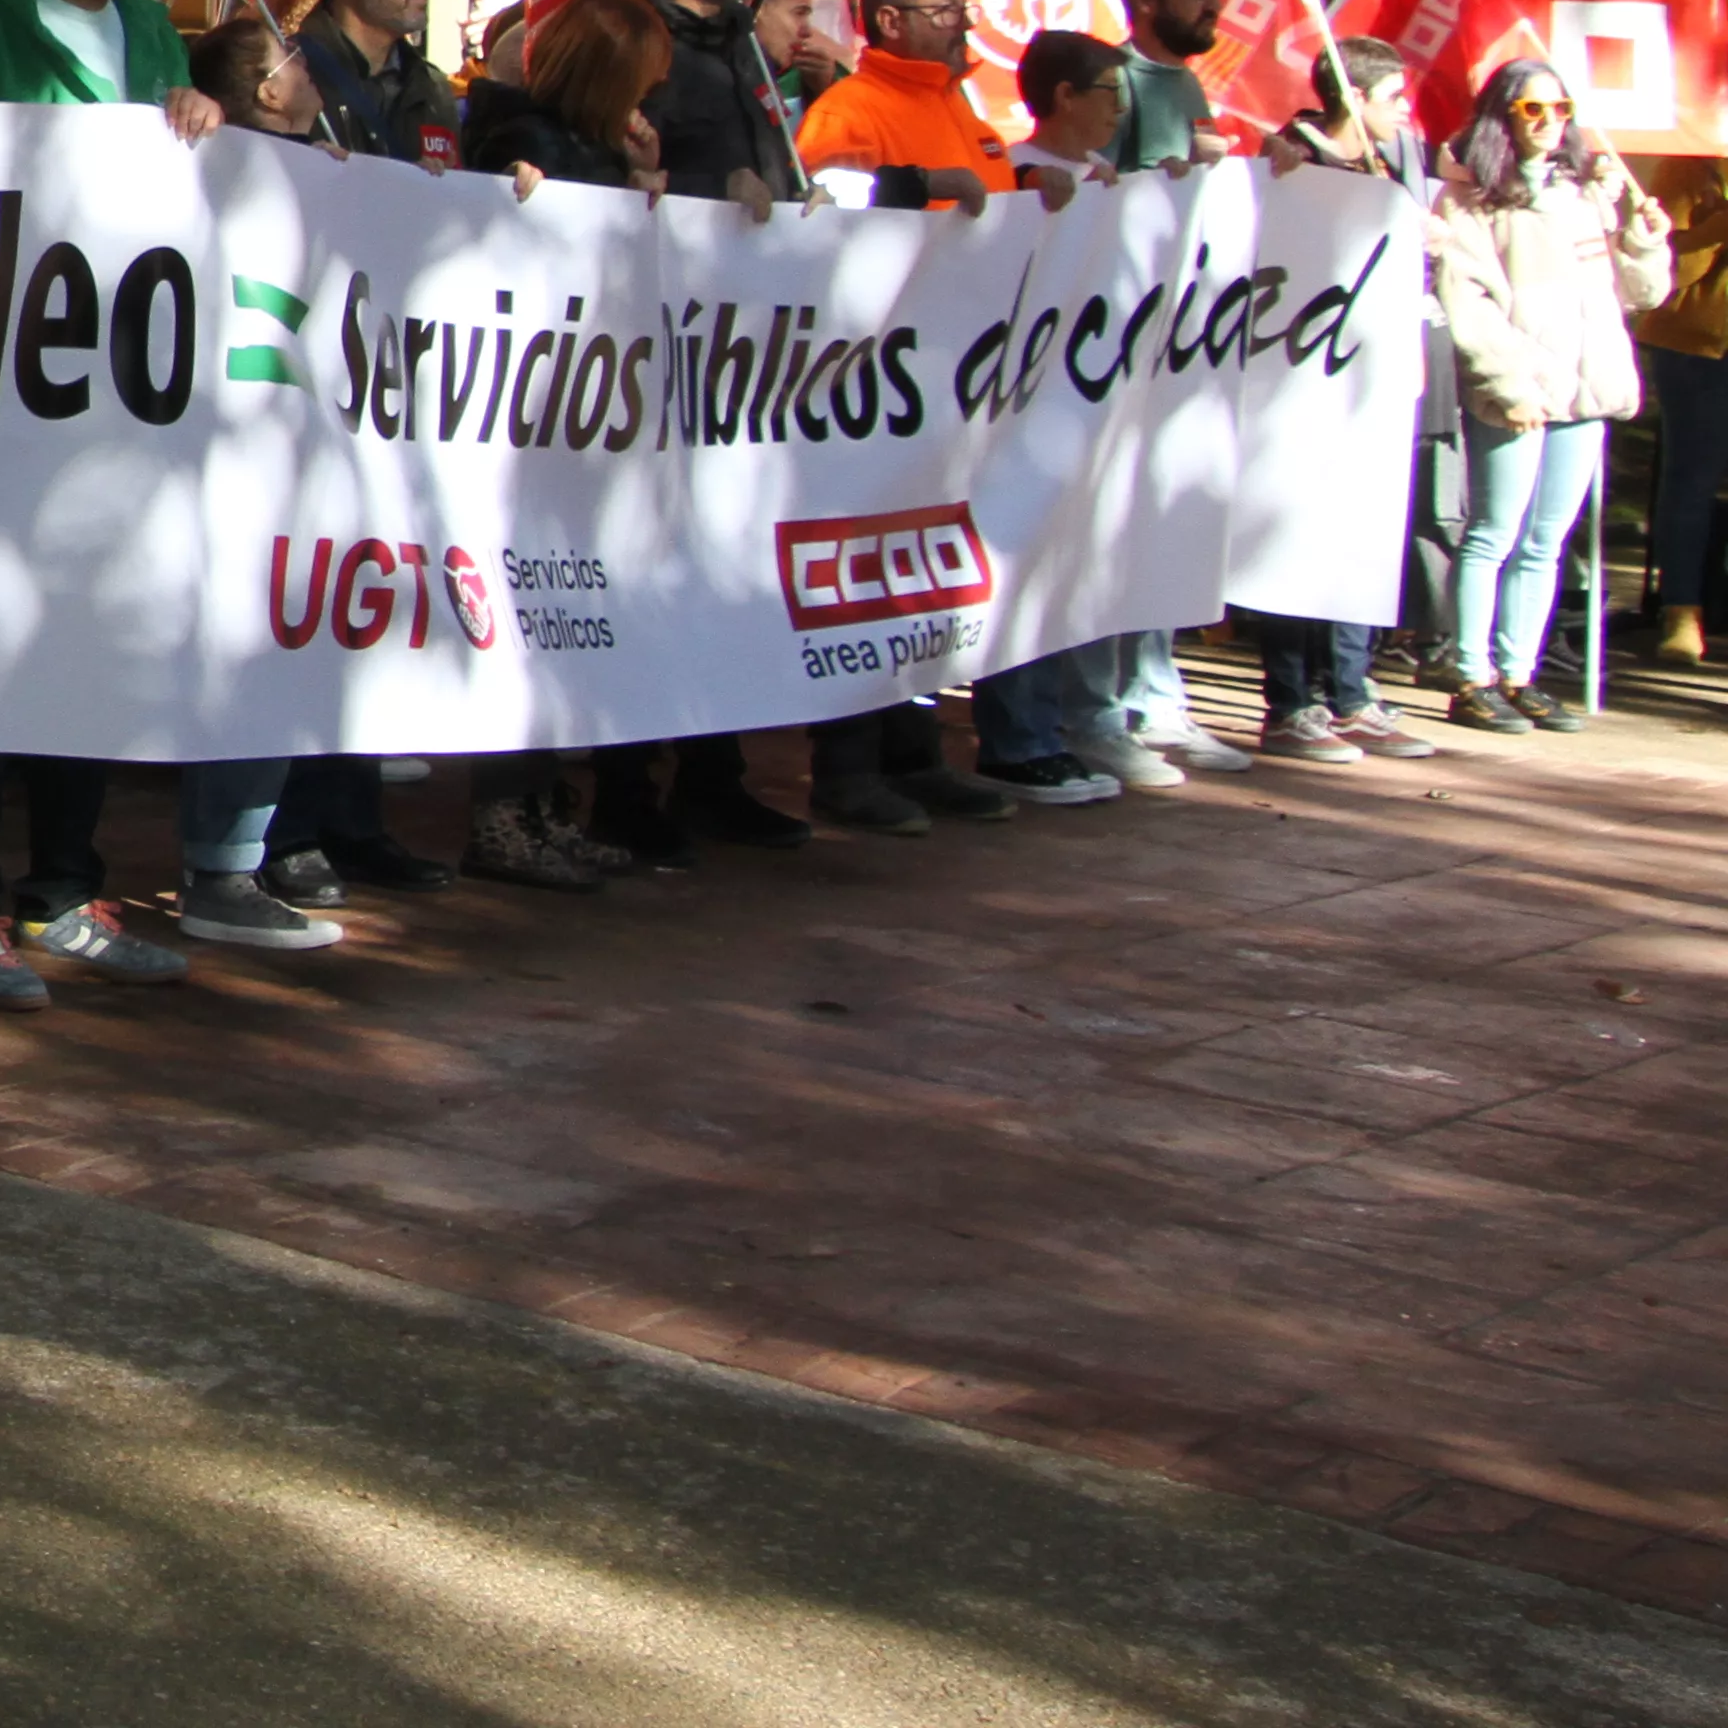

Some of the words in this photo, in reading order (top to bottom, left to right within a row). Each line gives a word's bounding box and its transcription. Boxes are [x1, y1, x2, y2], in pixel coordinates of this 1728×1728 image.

[335, 271, 654, 453] Servicios
[955, 250, 1060, 423] de
[269, 535, 430, 651] UGT
[502, 547, 608, 591] Servicios
[790, 523, 985, 609] CCOO
[516, 607, 615, 651] Públicos
[800, 636, 882, 680] área
[887, 616, 984, 676] pública
